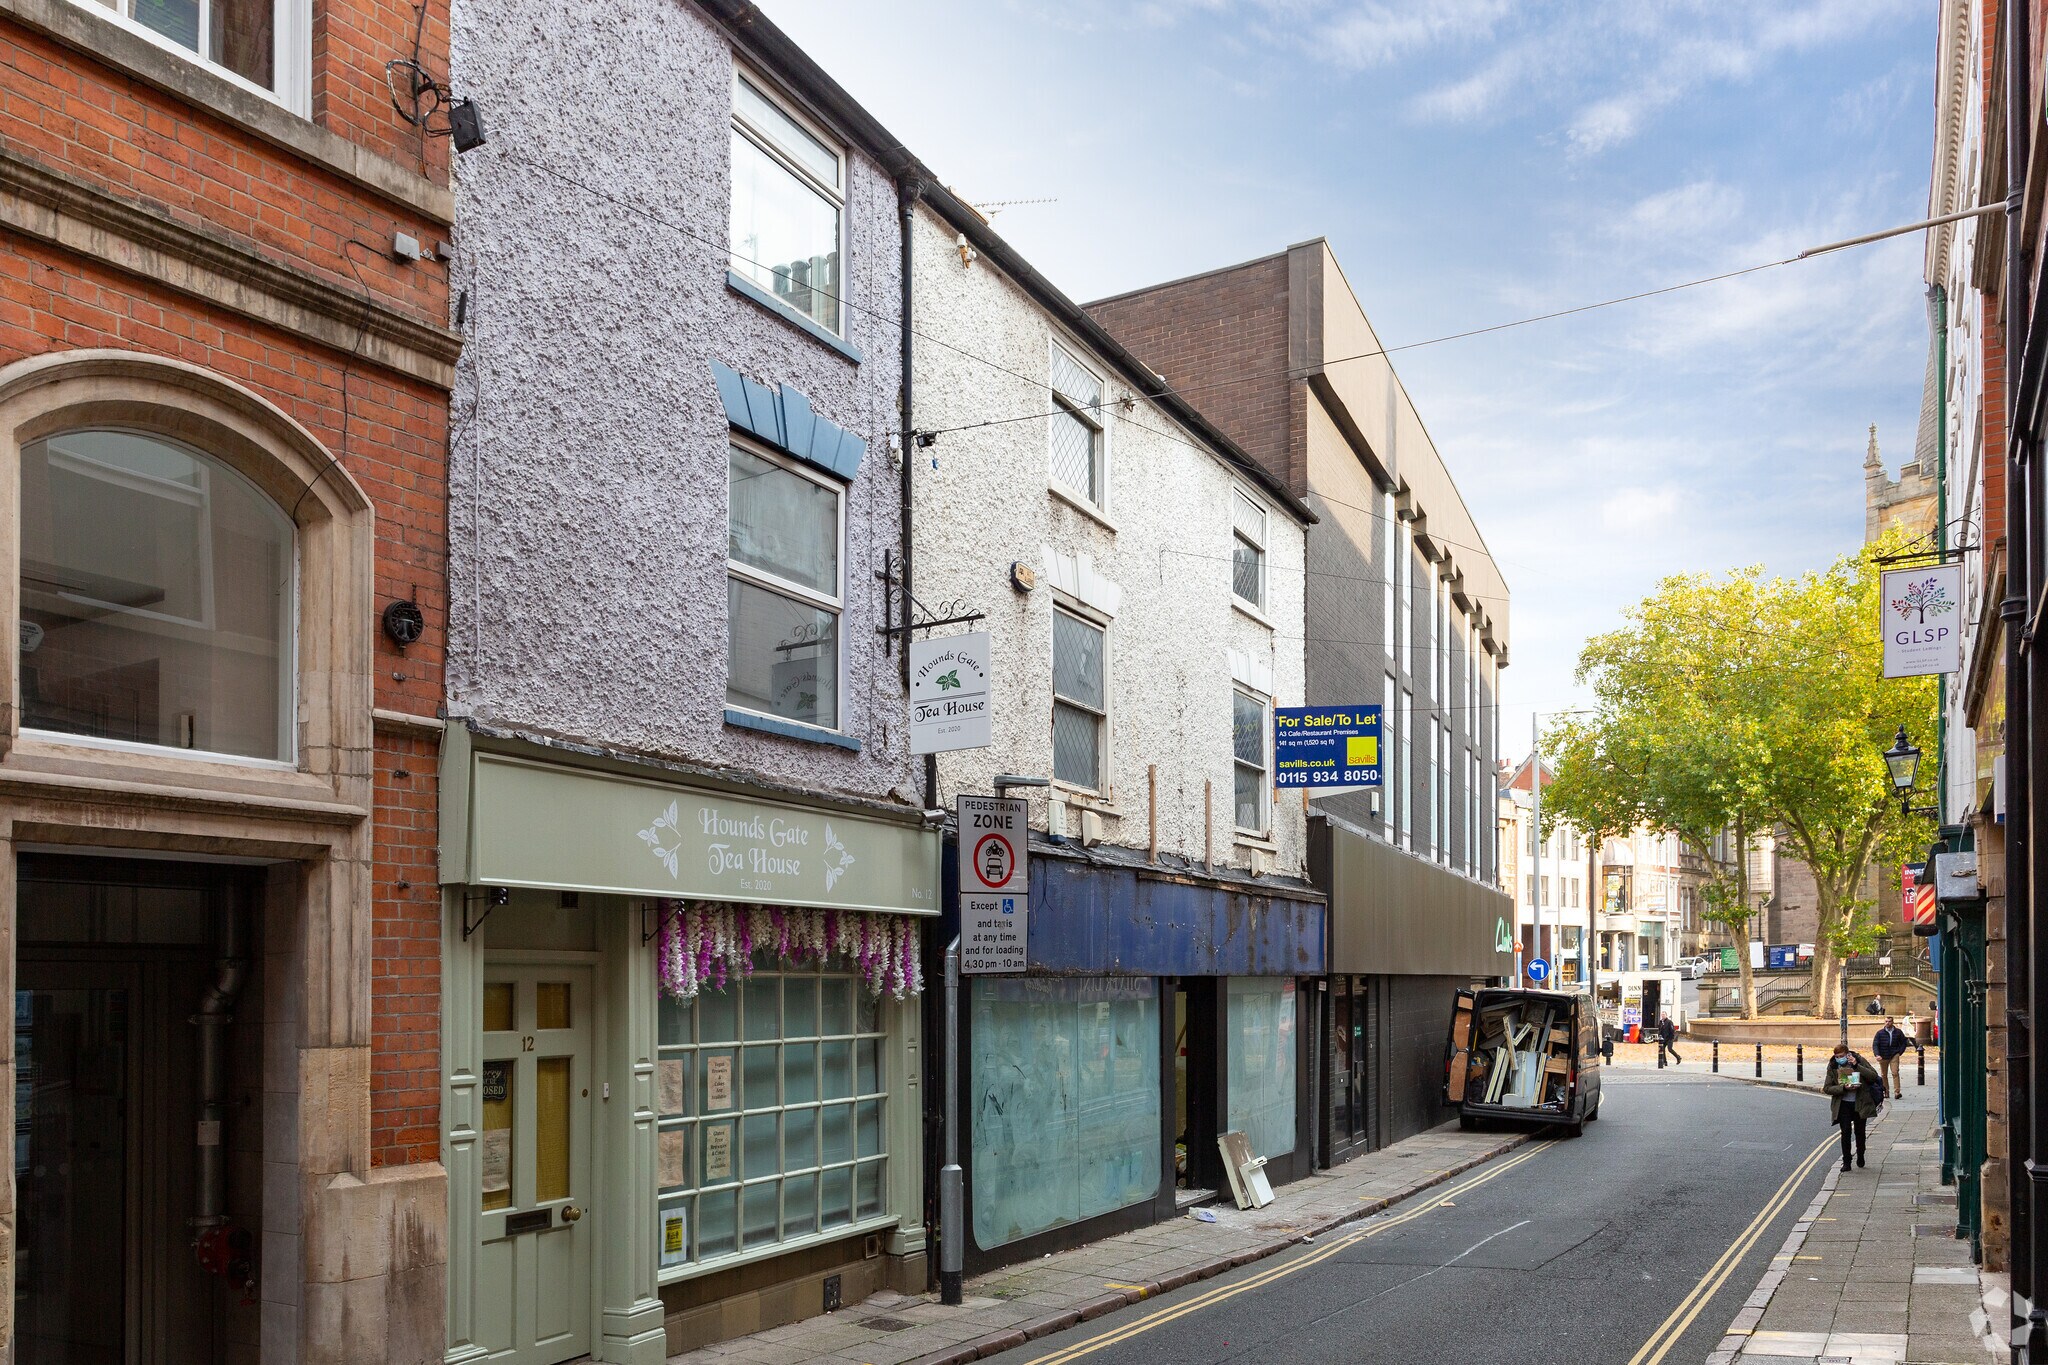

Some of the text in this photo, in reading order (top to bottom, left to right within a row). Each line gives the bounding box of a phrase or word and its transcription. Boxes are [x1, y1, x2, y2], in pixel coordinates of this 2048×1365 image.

[1895, 627, 1949, 645] GLSP
[917, 650, 980, 678] Hounds Gate
[914, 701, 985, 723] Tea House
[1278, 713, 1377, 728] For Sale/To Let
[948, 725, 961, 733] 2020
[1320, 739, 1328, 747] sq
[1279, 758, 1336, 769] savills.co.uk
[1348, 755, 1376, 764] savills
[1279, 769, 1378, 783] 0115 934 8050
[965, 800, 1021, 813] PEDESTRIAN
[698, 807, 809, 848] Hounds Gate
[973, 814, 1014, 829] ZONE
[707, 843, 801, 876] Tea House
[755, 879, 772, 891] 2020
[911, 887, 933, 900] No. 12
[970, 901, 998, 911] Except
[977, 919, 992, 928] and
[972, 932, 1017, 942] at any time
[965, 945, 1024, 956] and for loading
[964, 959, 984, 968] 4.30
[985, 961, 998, 970] pm
[1003, 958, 1012, 968] 10
[1013, 960, 1025, 968] am
[521, 1036, 535, 1052] 12
[483, 1085, 504, 1095] OSED
